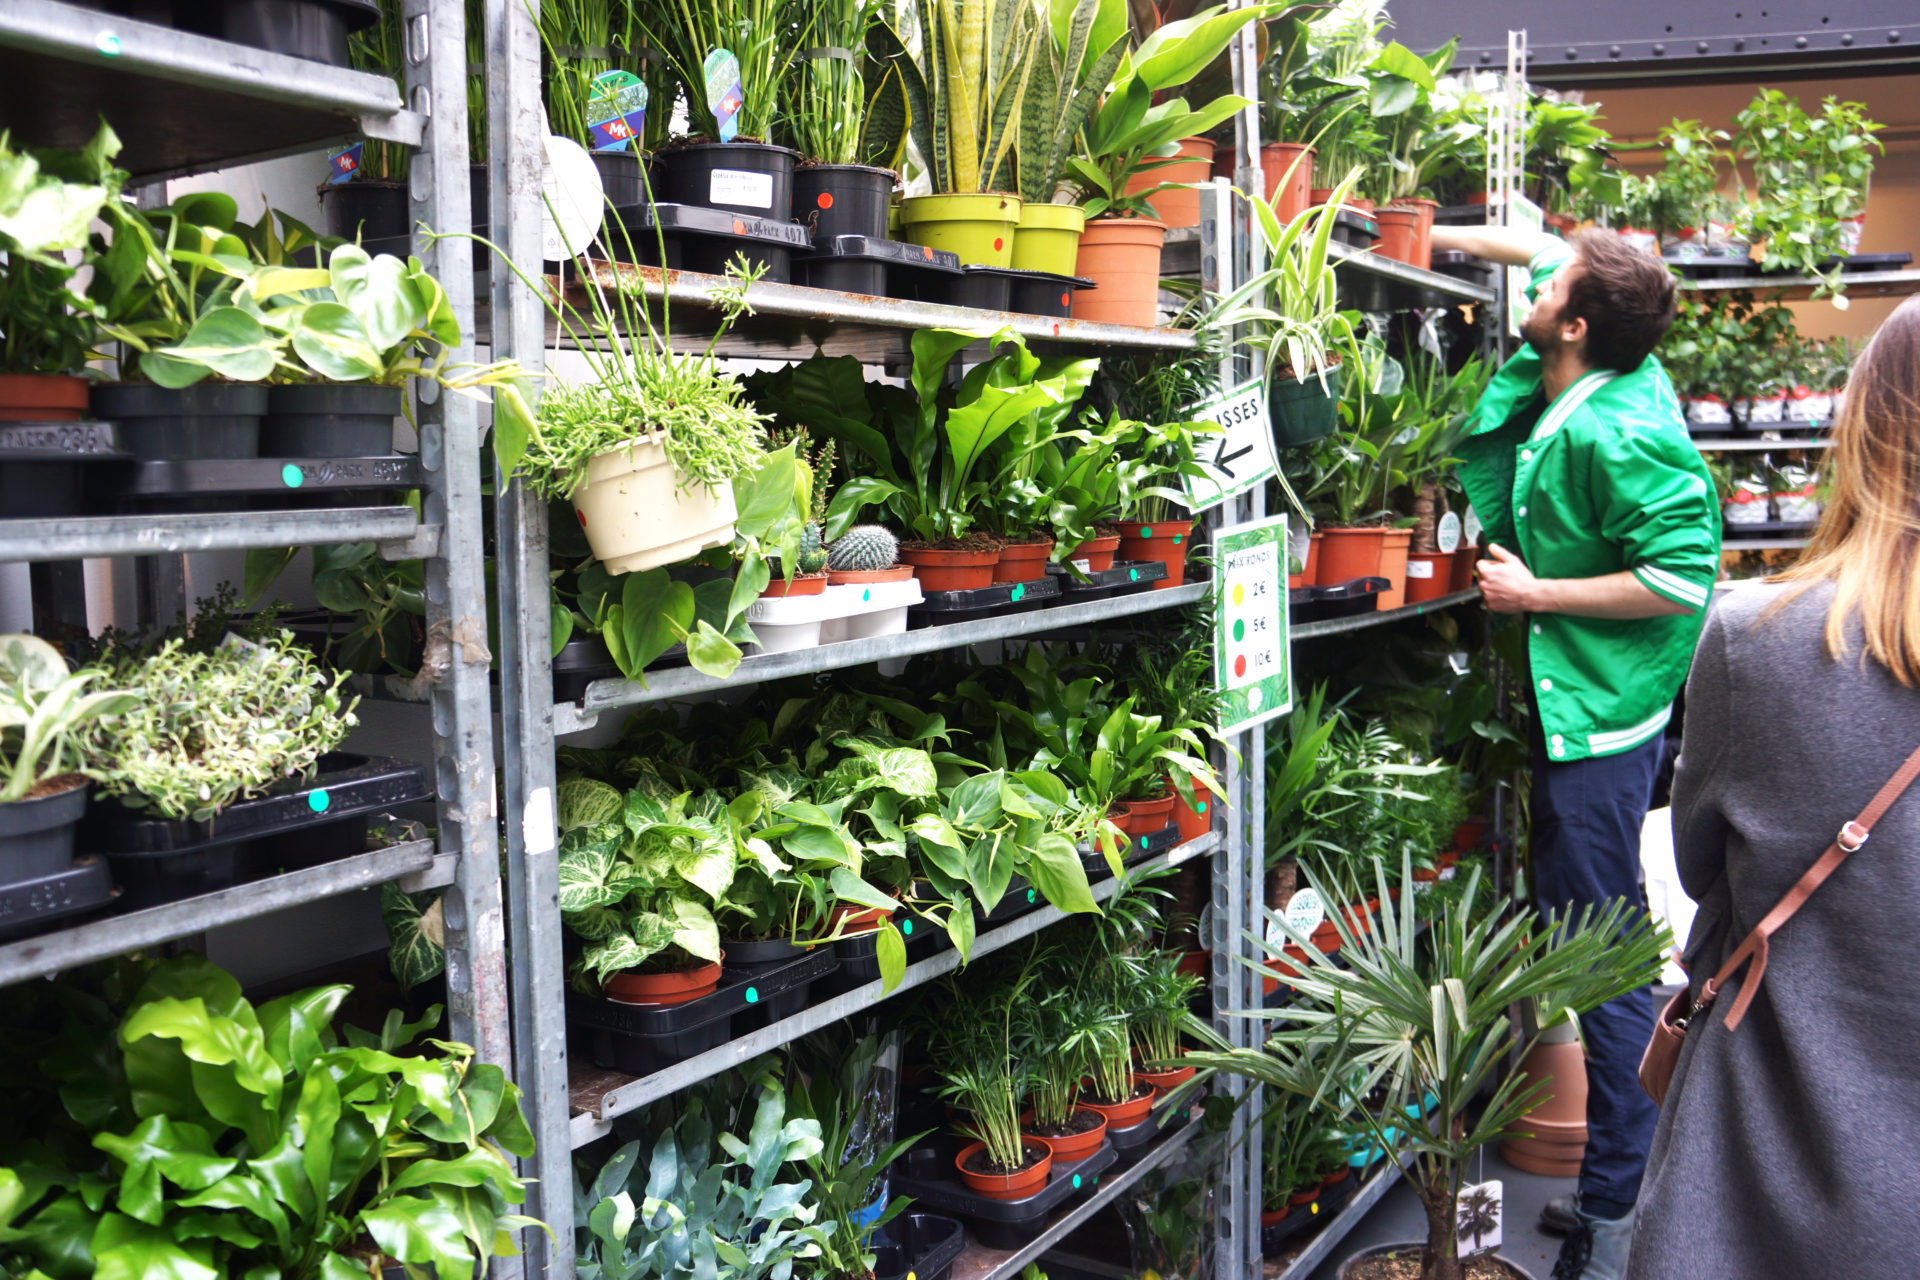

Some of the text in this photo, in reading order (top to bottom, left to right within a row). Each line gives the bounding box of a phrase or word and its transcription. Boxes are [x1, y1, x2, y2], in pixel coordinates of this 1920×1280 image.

[609, 122, 626, 138] MK
[340, 156, 352, 170] MK
[1215, 398, 1258, 428] ISSES
[1253, 581, 1266, 596] 2€
[1253, 617, 1266, 632] 5€
[1254, 650, 1271, 667] 10€
